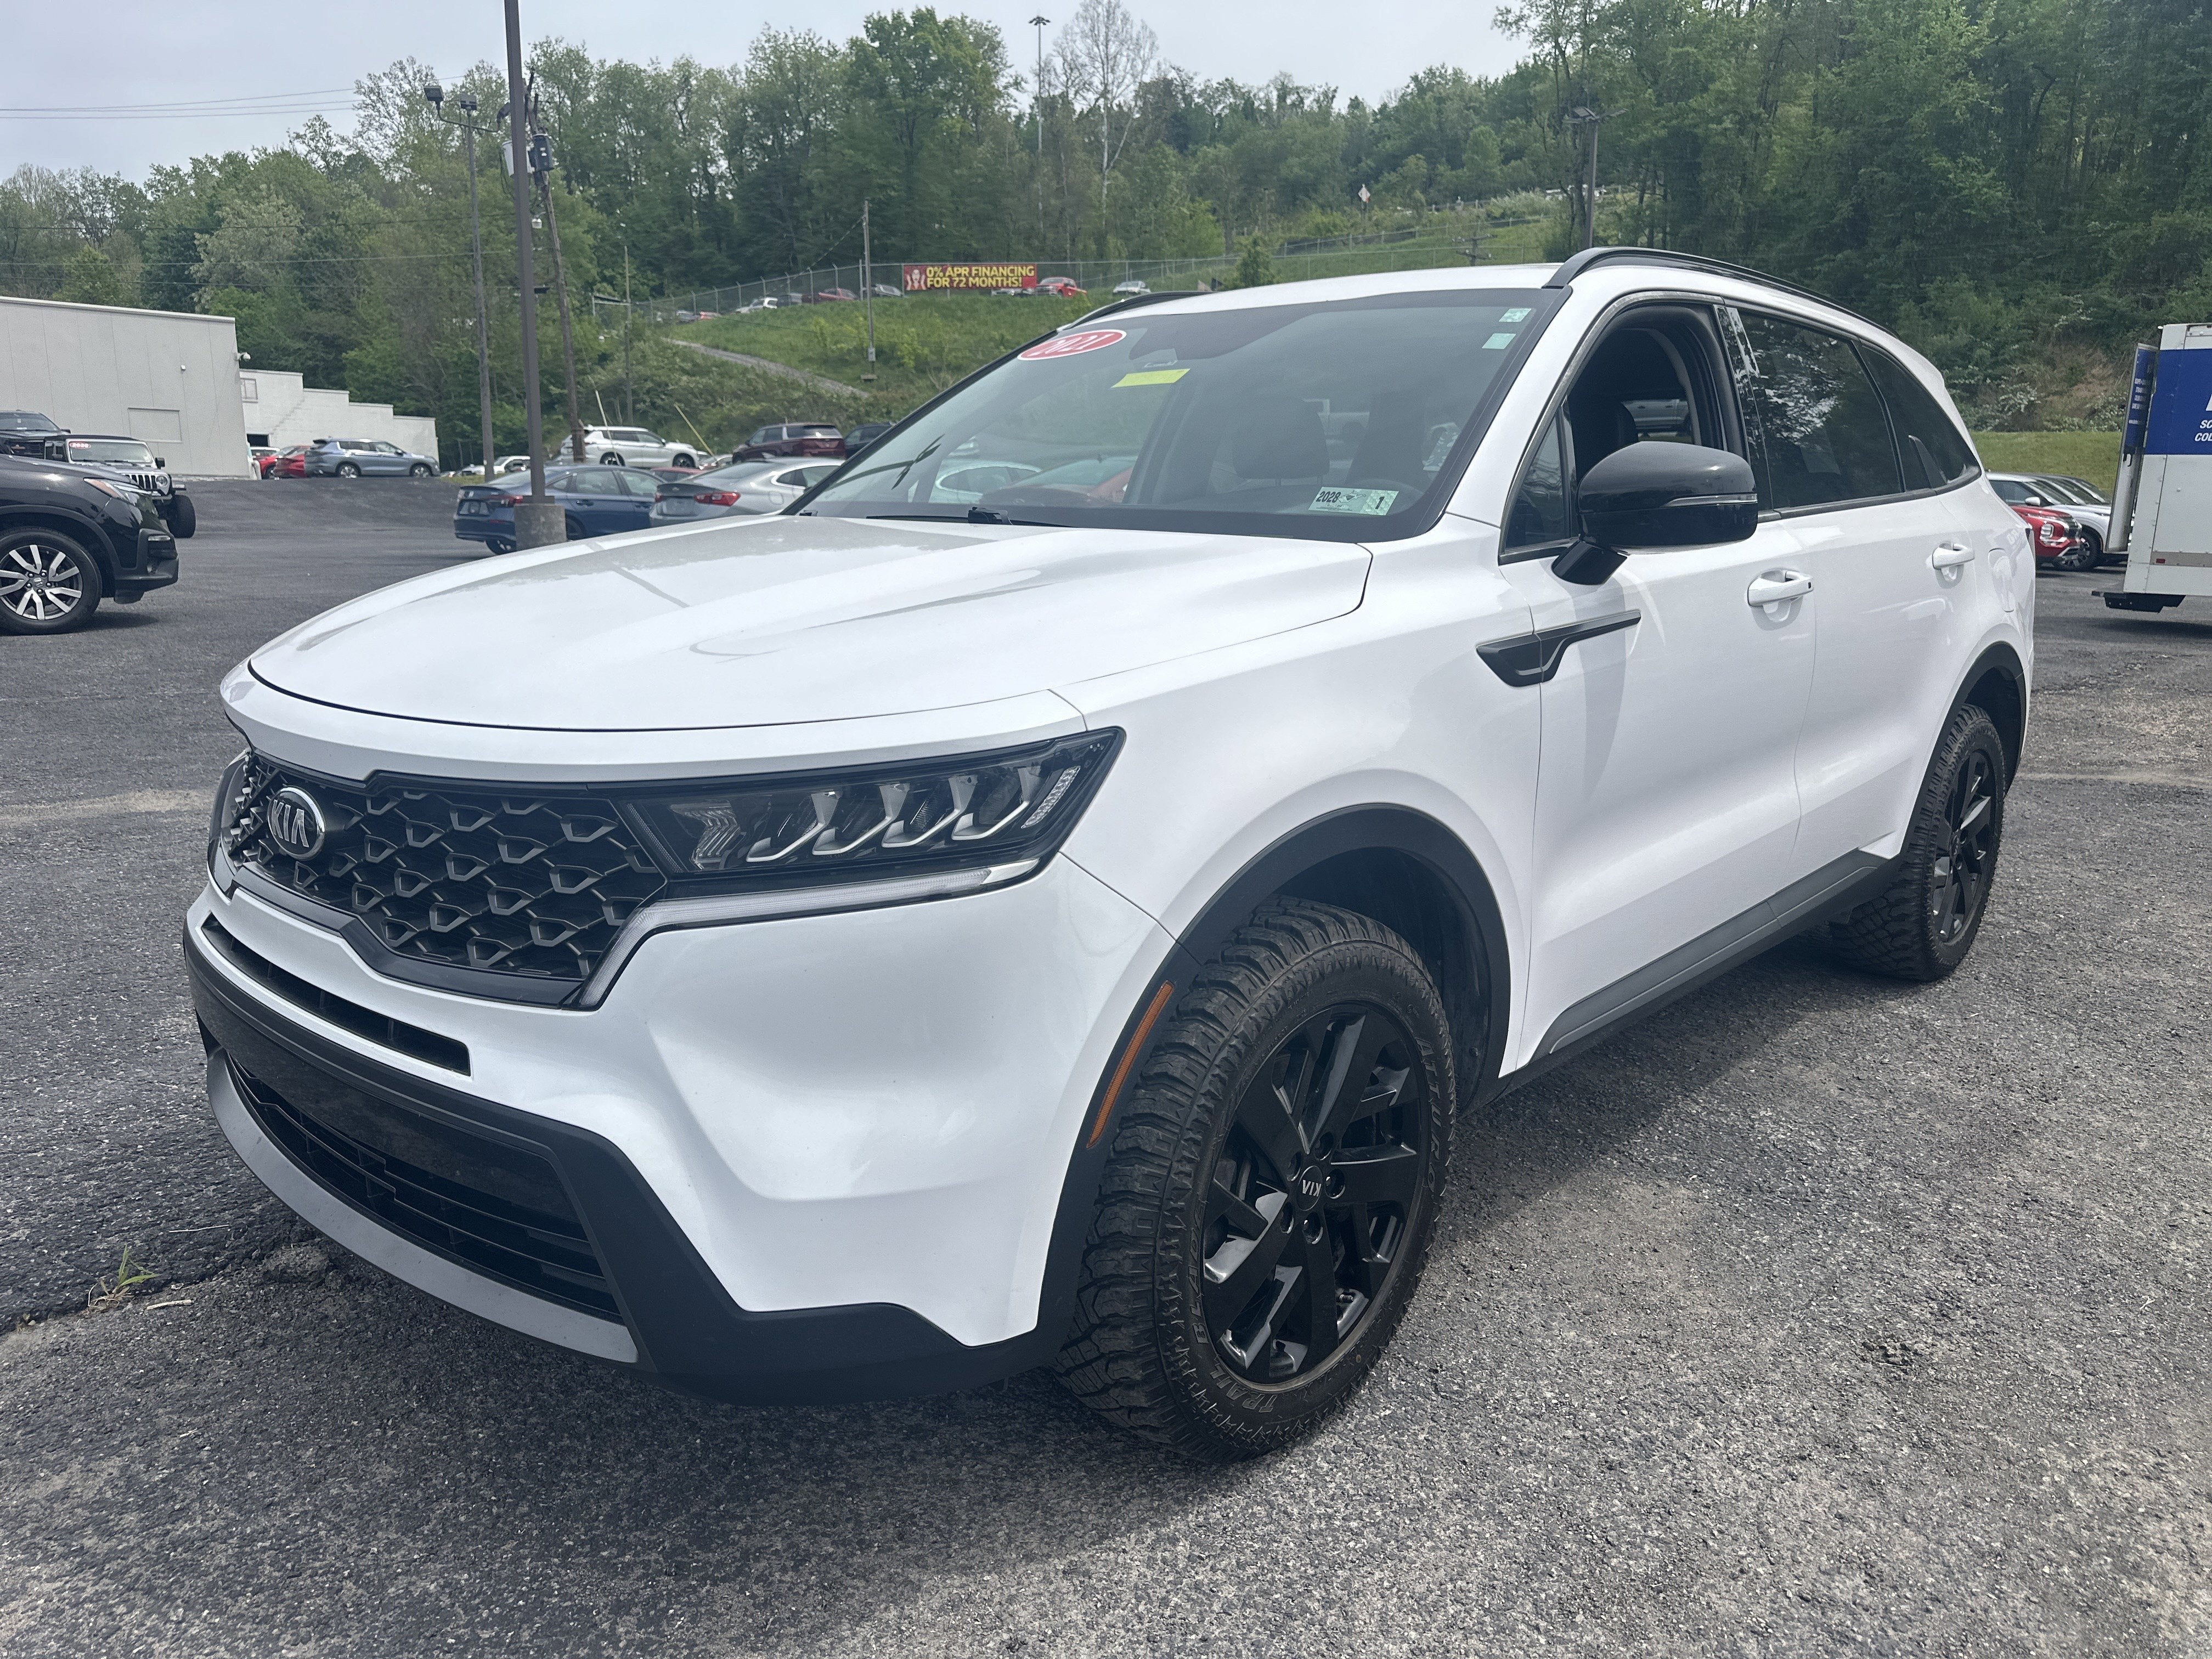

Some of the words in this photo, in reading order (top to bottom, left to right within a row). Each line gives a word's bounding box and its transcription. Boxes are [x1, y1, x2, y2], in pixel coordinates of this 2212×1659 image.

[927, 267, 943, 277] 0%
[945, 267, 969, 277] APR
[972, 266, 1035, 277] FINANCING
[927, 278, 950, 287] FOR
[953, 277, 966, 287] 72
[969, 277, 1022, 287] MONTHS!
[1316, 491, 1341, 503] 2028
[1375, 496, 1385, 510] 1
[272, 799, 309, 848] KIA
[1415, 1037, 1442, 1193] ATTURO
[1302, 1180, 1321, 1197] KIA
[1210, 1363, 1278, 1413] TRAIL
